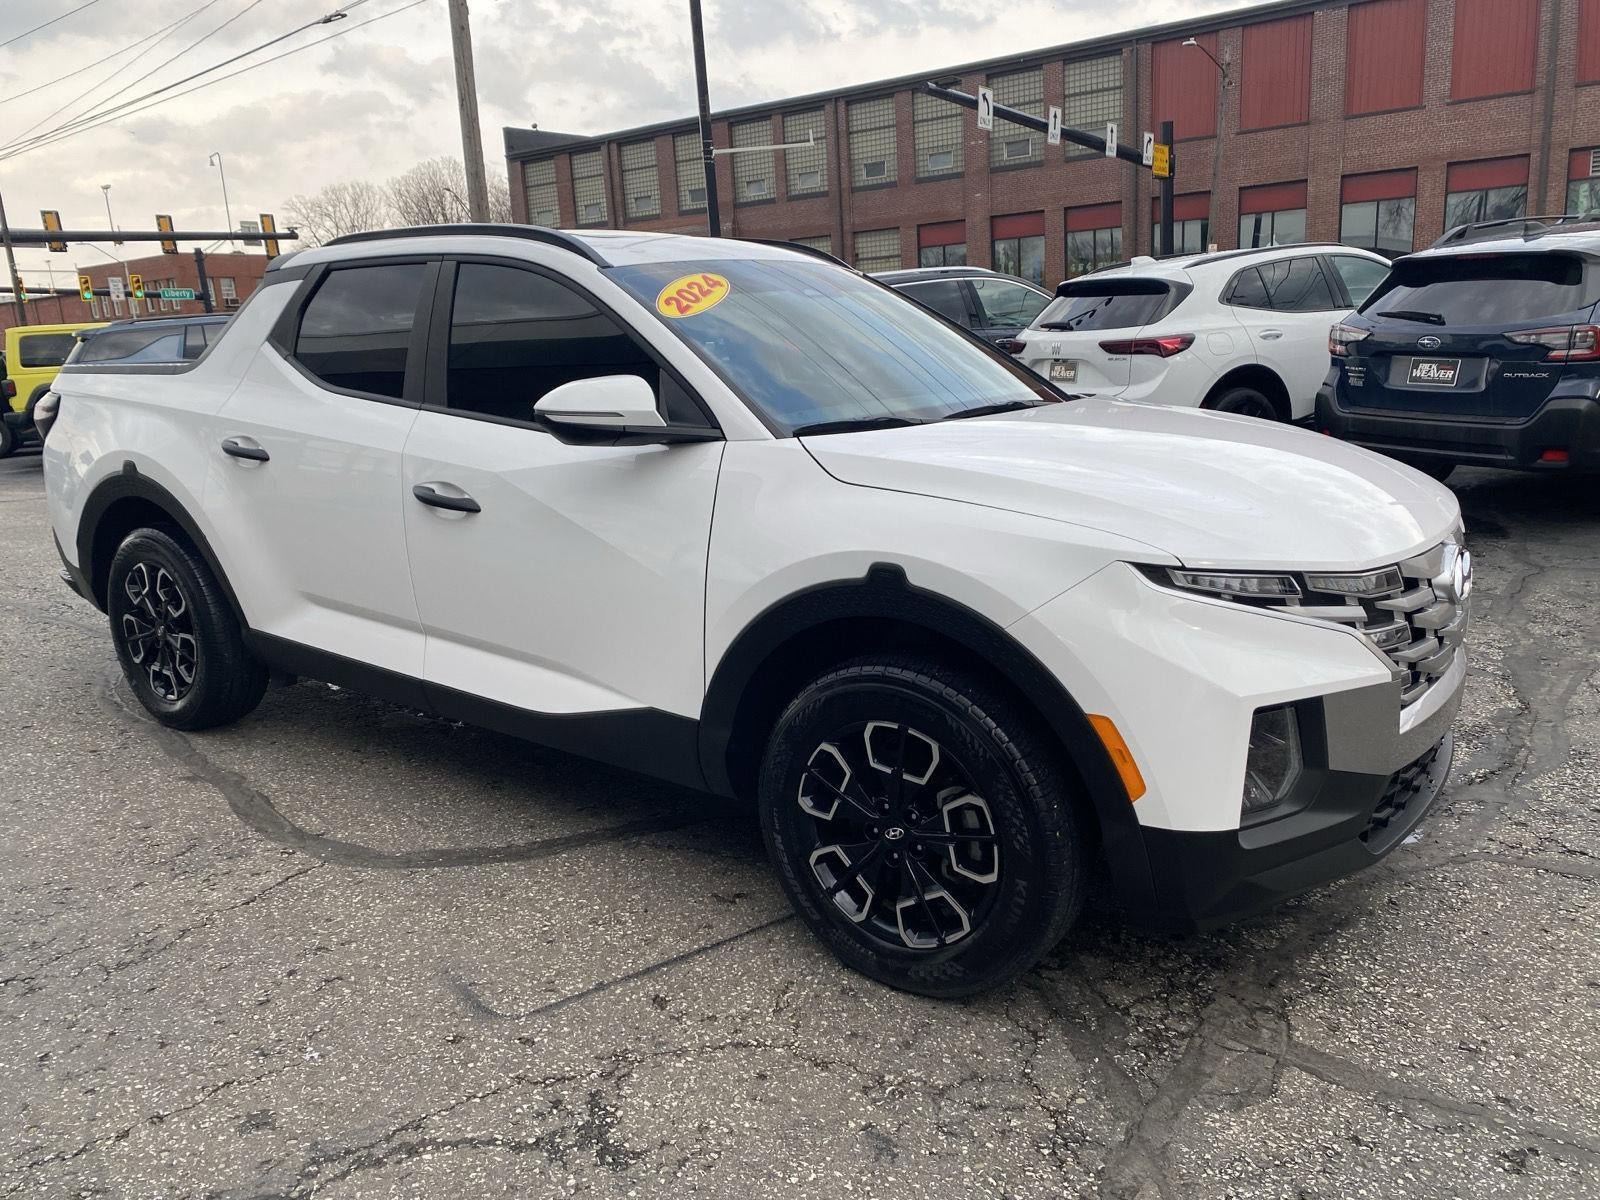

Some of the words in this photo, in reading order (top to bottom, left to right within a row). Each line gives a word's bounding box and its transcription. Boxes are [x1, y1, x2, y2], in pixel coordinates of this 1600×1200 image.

[164, 289, 191, 298] Liberty
[664, 274, 723, 314] 2024
[1418, 363, 1439, 371] RICK
[1412, 369, 1455, 378] WEAVER
